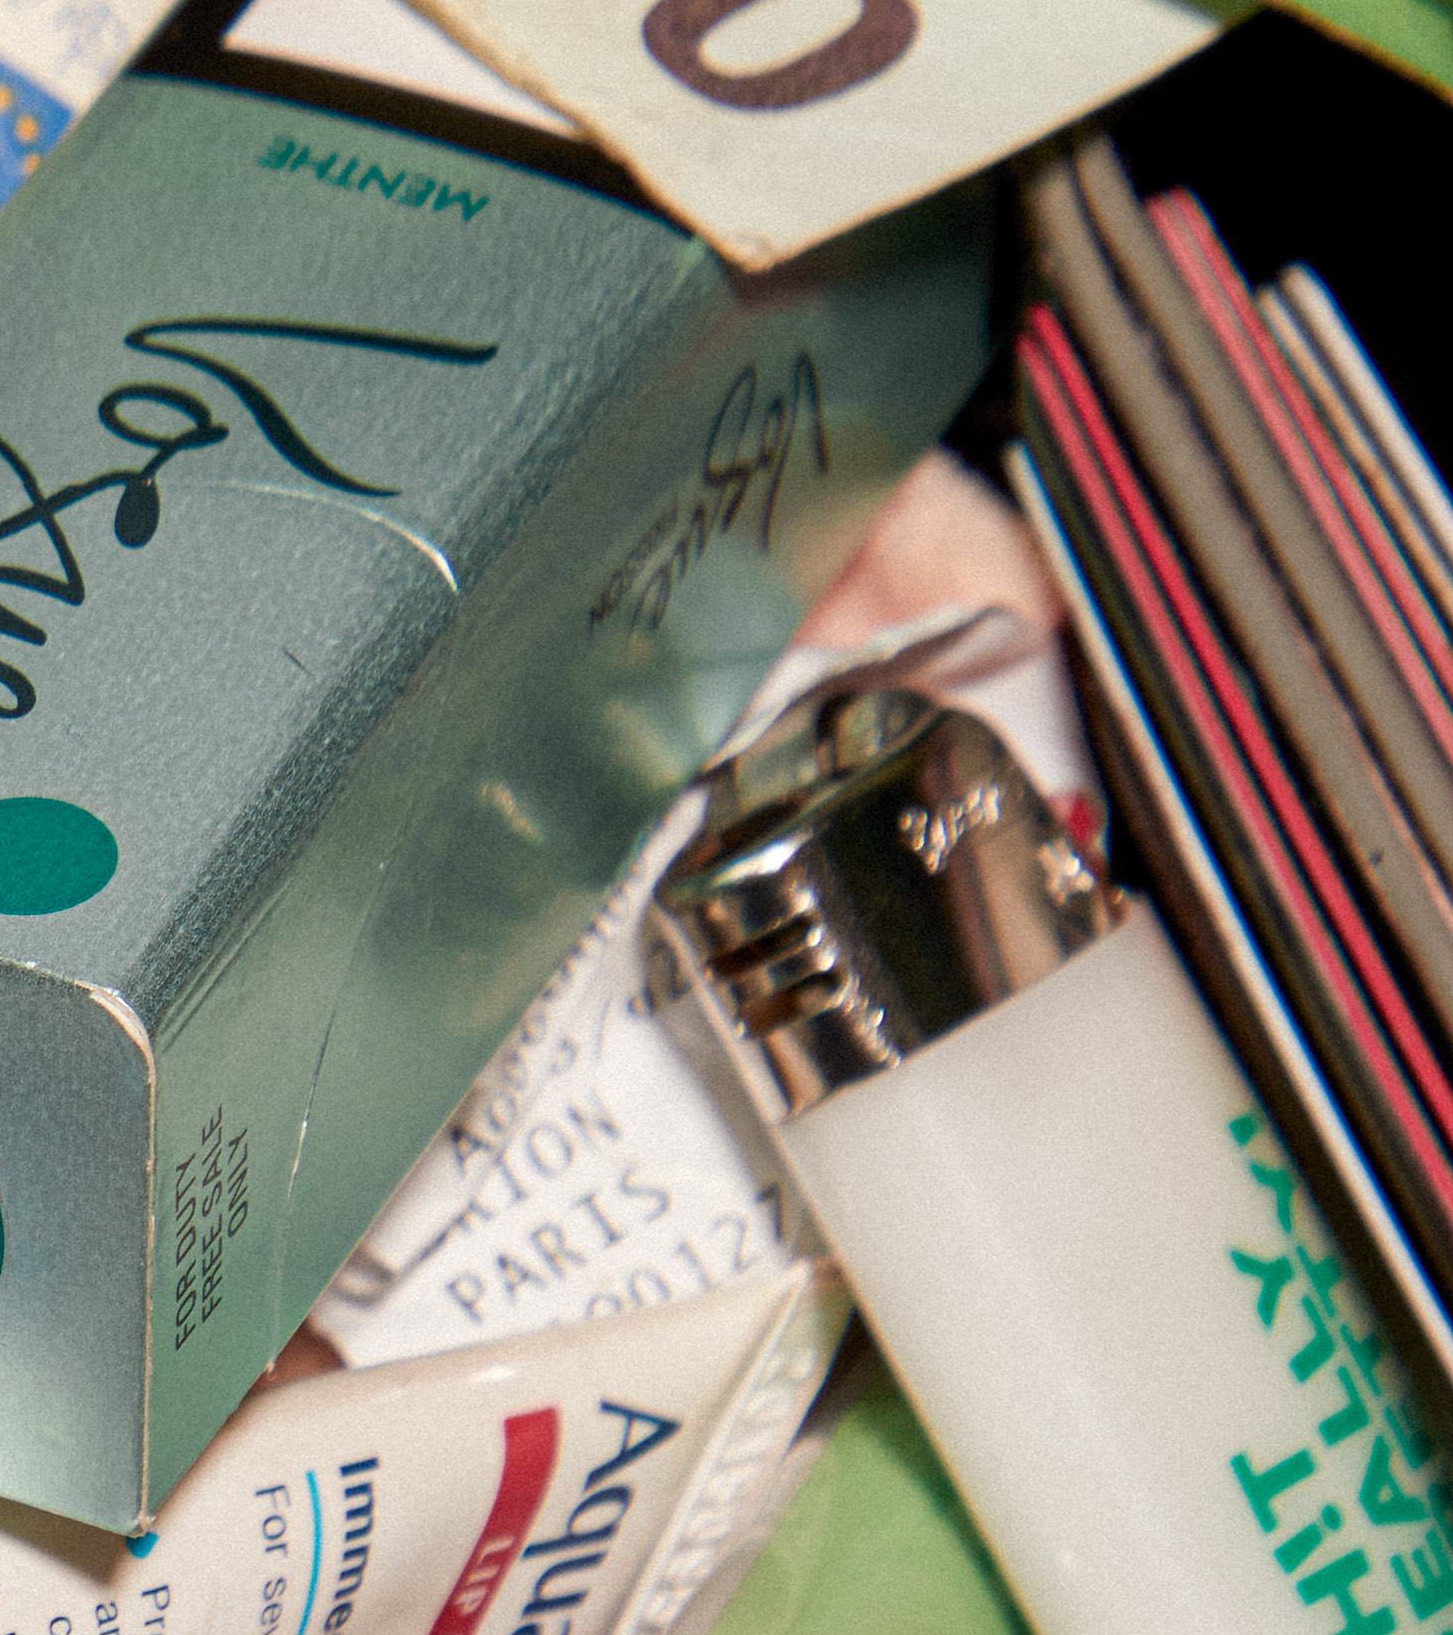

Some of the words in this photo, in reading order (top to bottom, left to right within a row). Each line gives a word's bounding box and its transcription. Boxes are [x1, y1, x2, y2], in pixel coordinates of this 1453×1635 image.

[260, 133, 492, 226] MENTHE
[175, 1151, 197, 1268] DUTY
[201, 1103, 224, 1218] SALE
[227, 1127, 249, 1239] ONLY
[201, 1212, 224, 1324] FREE
[444, 1163, 674, 1326] PARIS
[175, 1258, 197, 1352] FOR
[253, 1482, 291, 1562] For
[459, 1533, 518, 1617] LIP
